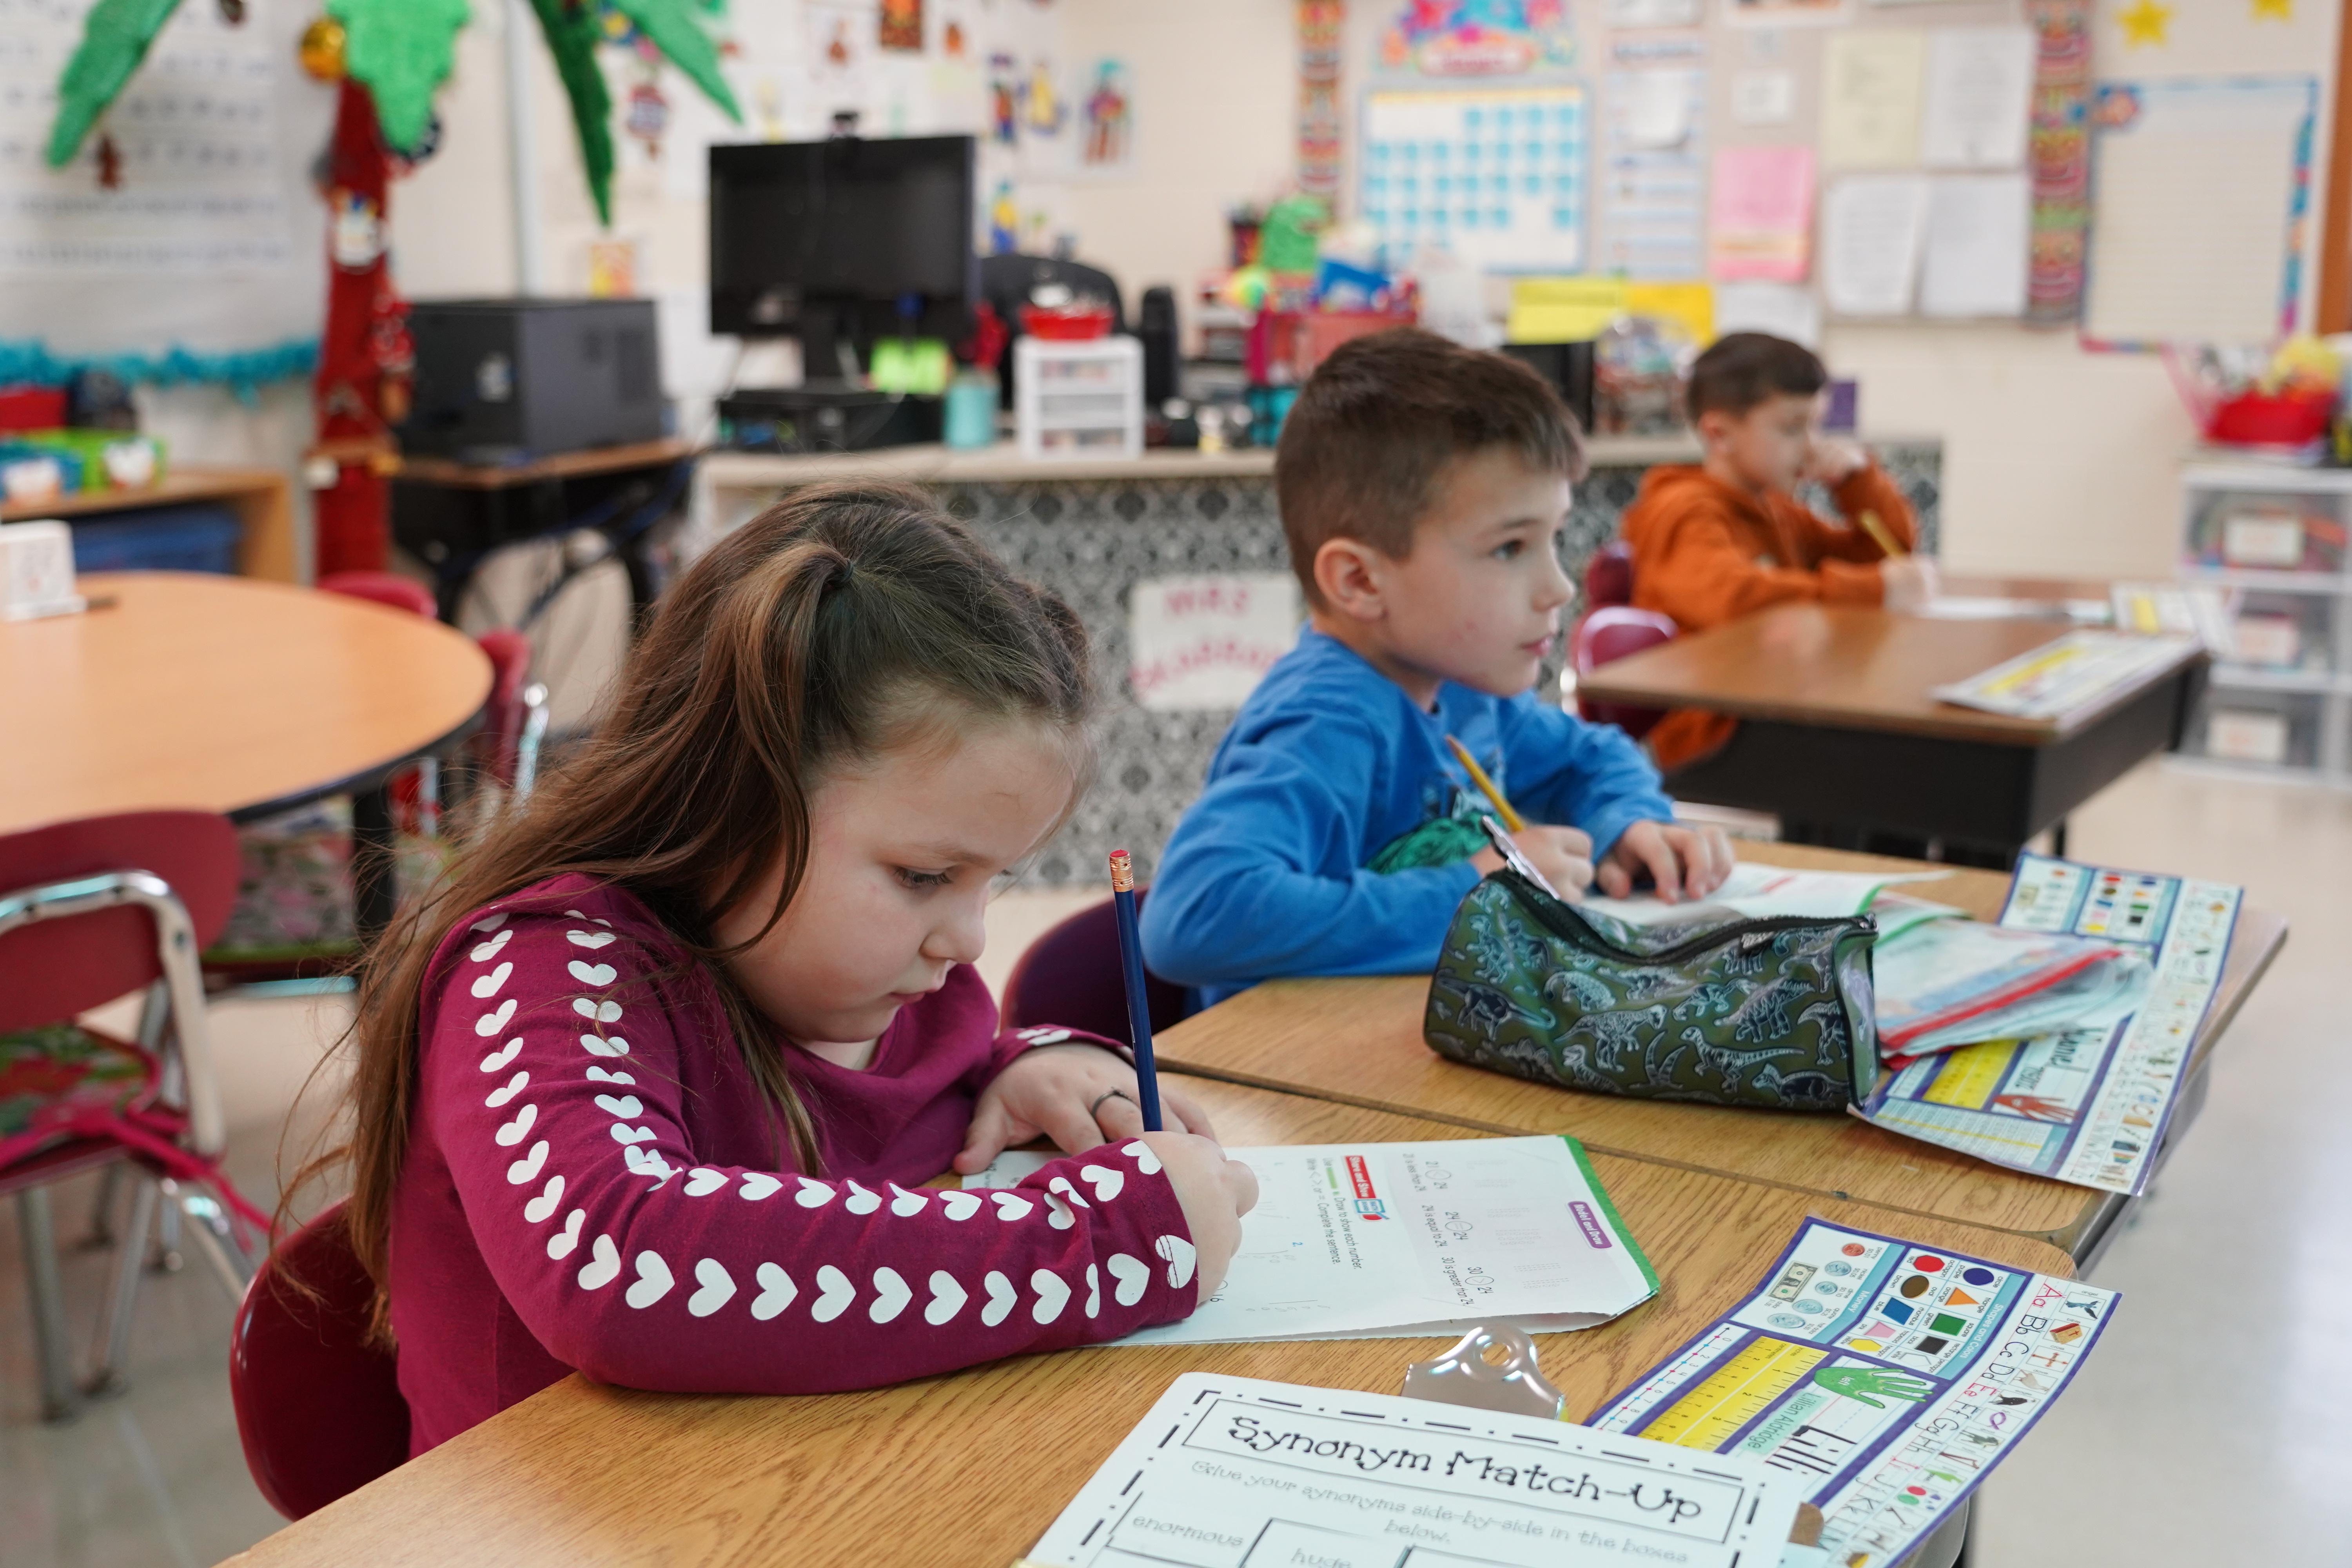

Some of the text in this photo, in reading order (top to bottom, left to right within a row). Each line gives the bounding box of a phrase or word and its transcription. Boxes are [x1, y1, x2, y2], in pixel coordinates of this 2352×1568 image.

[1349, 1156, 1370, 1197] Share and Show
[1334, 1198, 1346, 1211] Draw
[1317, 1203, 1333, 1228] Complete
[1573, 1204, 1603, 1244] Model and Draw
[1324, 1229, 1337, 1238] the
[1340, 1218, 1352, 1232] show
[1425, 1218, 1443, 1232] equal
[1344, 1233, 1359, 1246] each
[1326, 1239, 1341, 1265] sentence.
[1348, 1248, 1364, 1269] number.
[1907, 1256, 1915, 1264] red
[1940, 1259, 1955, 1278] octagon
[1954, 1265, 1965, 1279] purple
[1443, 1270, 1462, 1287] greater
[1455, 1288, 1468, 1298] than
[1890, 1275, 1903, 1288] brown
[1993, 1276, 2004, 1288] circle
[1928, 1286, 1937, 1296] oval
[1938, 1287, 1951, 1303] orange
[1847, 1290, 1870, 1313] Money
[1874, 1301, 1885, 1311] blue
[1977, 1297, 1992, 1313] triangle
[1908, 1307, 1925, 1326] rhombus
[1922, 1313, 1934, 1326] green
[1960, 1303, 2004, 1359] Shapes and Colors
[1961, 1322, 1974, 1337] square
[1790, 1347, 1805, 1357] inches
[1838, 1376, 1855, 1386] left
[1747, 1392, 1822, 1449] Lillian Aldridge
[1765, 1425, 1858, 1475] Lilli
[1228, 1416, 1702, 1523] Synonym Match-Up
[1191, 1460, 1689, 1563] Glue your synonyms side-by-side in the boxes
[1132, 1514, 1244, 1548] enormous
[1384, 1519, 1451, 1543] below.
[1290, 1548, 1352, 1568] huge
